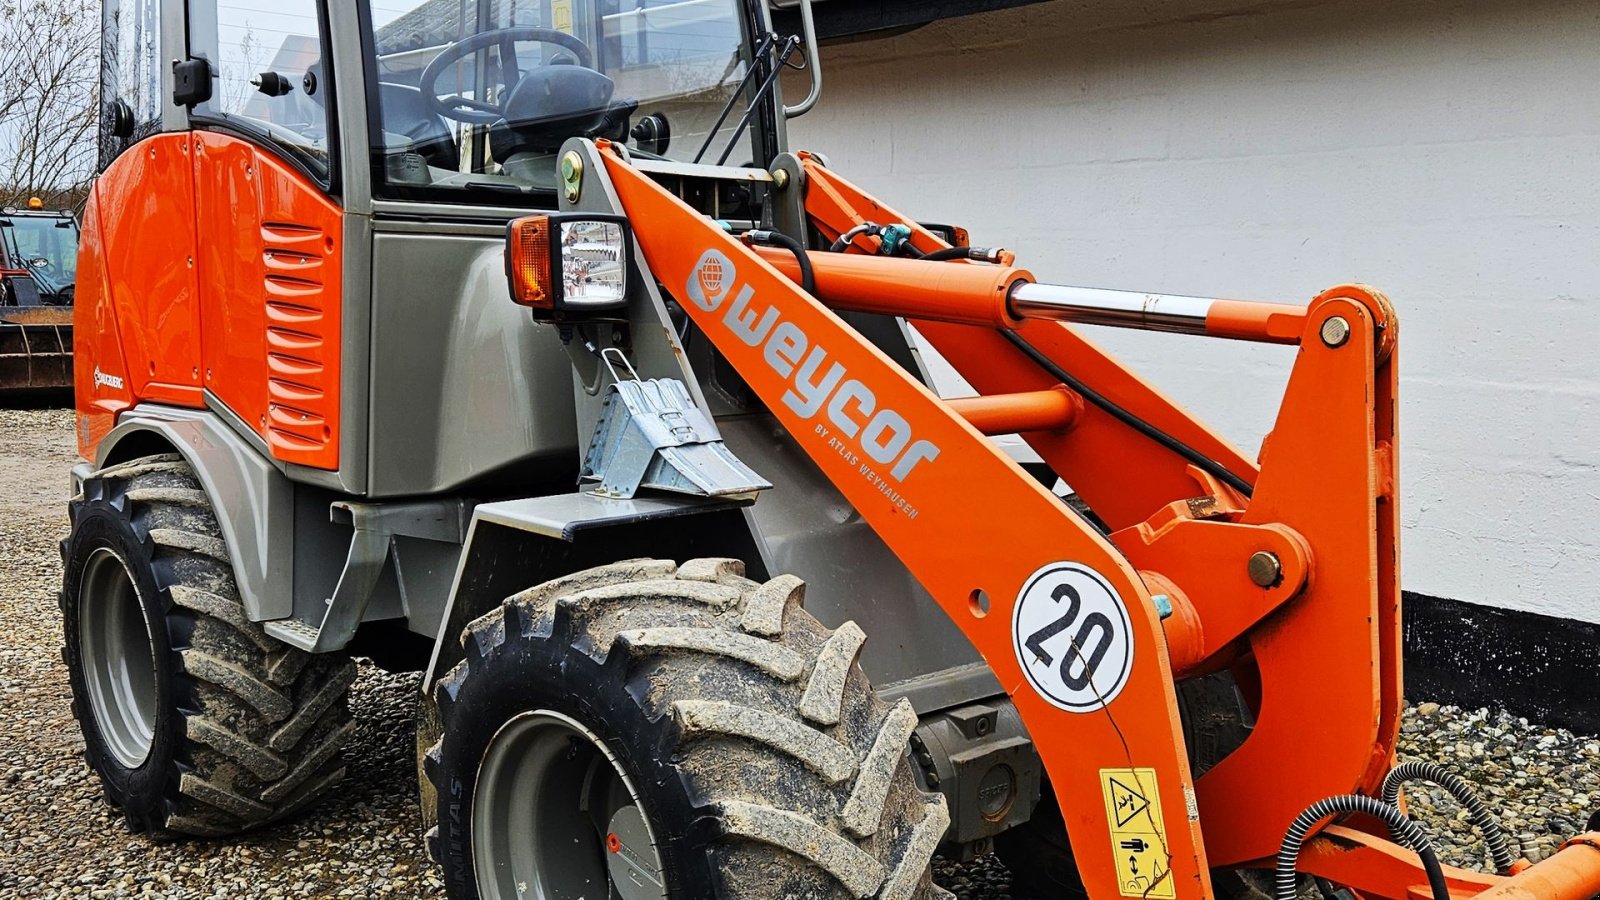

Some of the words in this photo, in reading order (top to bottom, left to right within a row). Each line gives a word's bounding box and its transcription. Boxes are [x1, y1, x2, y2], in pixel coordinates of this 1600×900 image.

[722, 283, 941, 482] weycor
[815, 424, 829, 438] BY
[828, 437, 858, 465] ATLAS
[859, 464, 918, 519] WEYHAUSEN
[1025, 583, 1114, 691] 20
